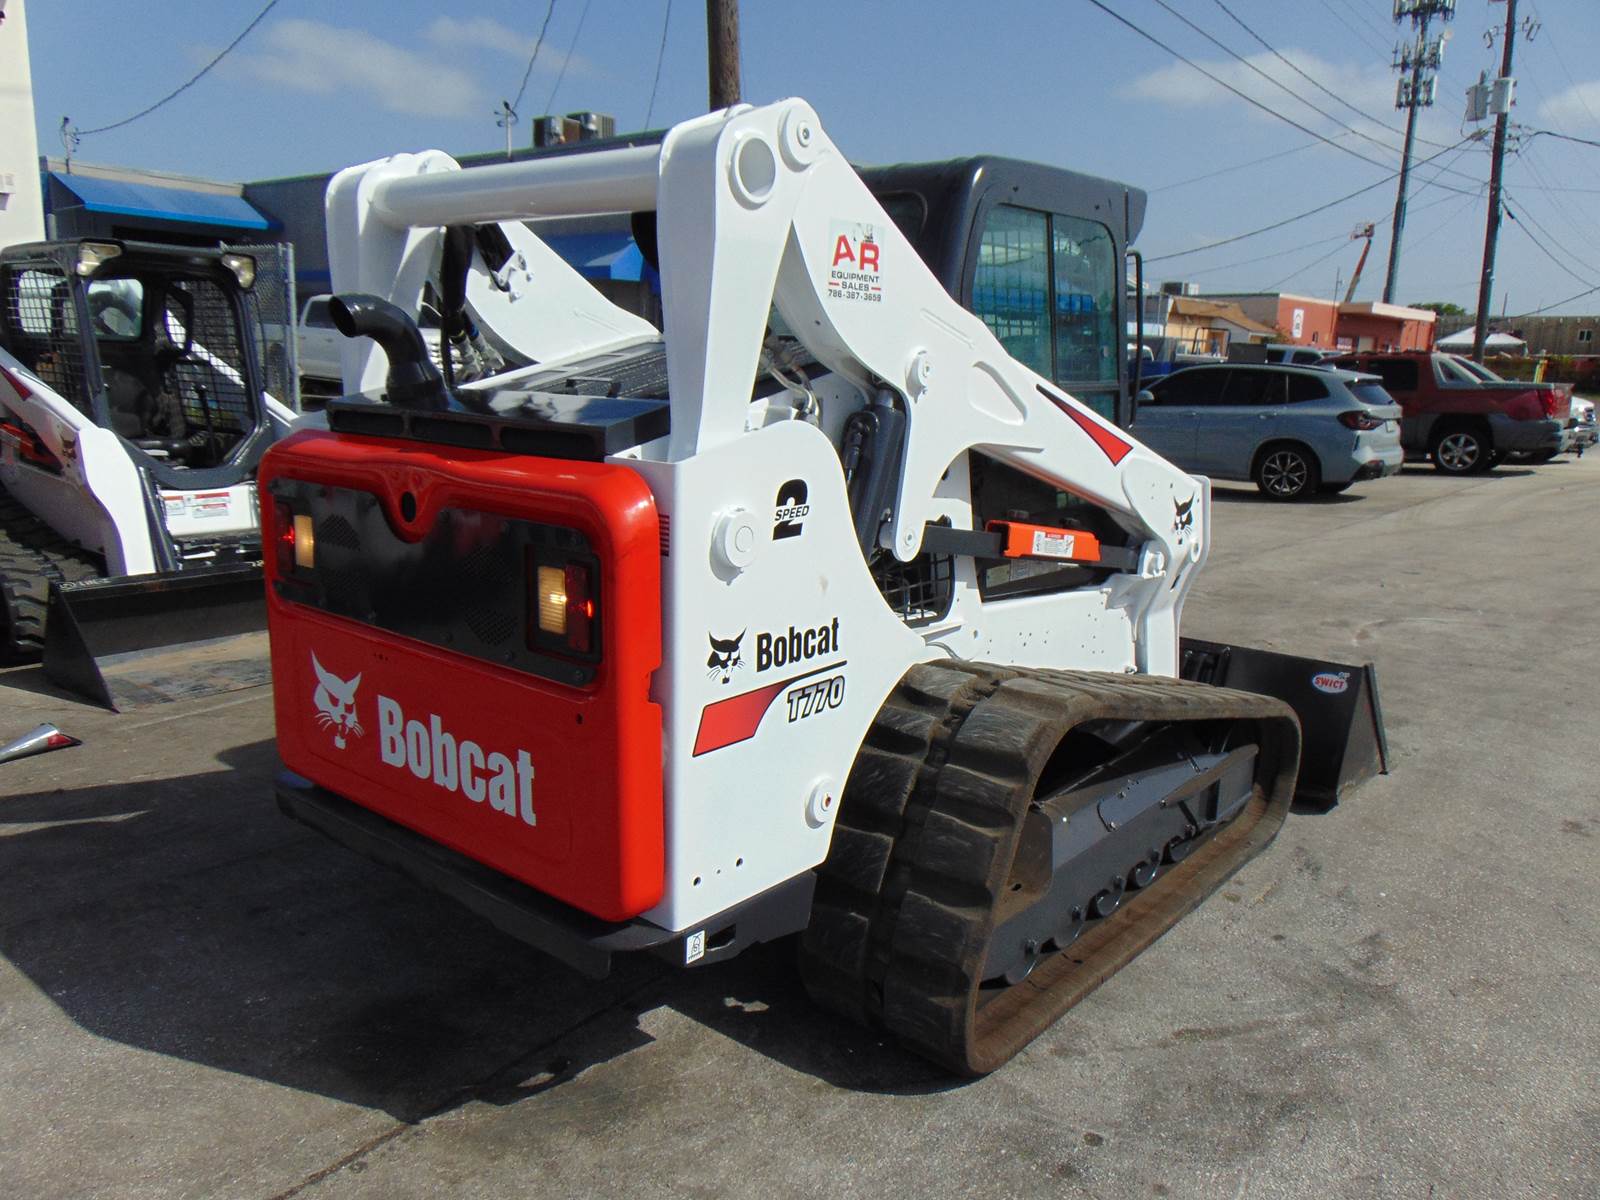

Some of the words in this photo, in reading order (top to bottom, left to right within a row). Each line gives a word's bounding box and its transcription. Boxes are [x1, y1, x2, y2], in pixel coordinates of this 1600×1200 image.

[831, 270, 880, 283] EQUIPMENT
[841, 281, 869, 292] SALES
[772, 479, 808, 540] 2
[774, 505, 810, 521] SPEED
[756, 617, 839, 673] Bobcat
[786, 675, 845, 723] T770
[377, 694, 537, 827] Bobcat
